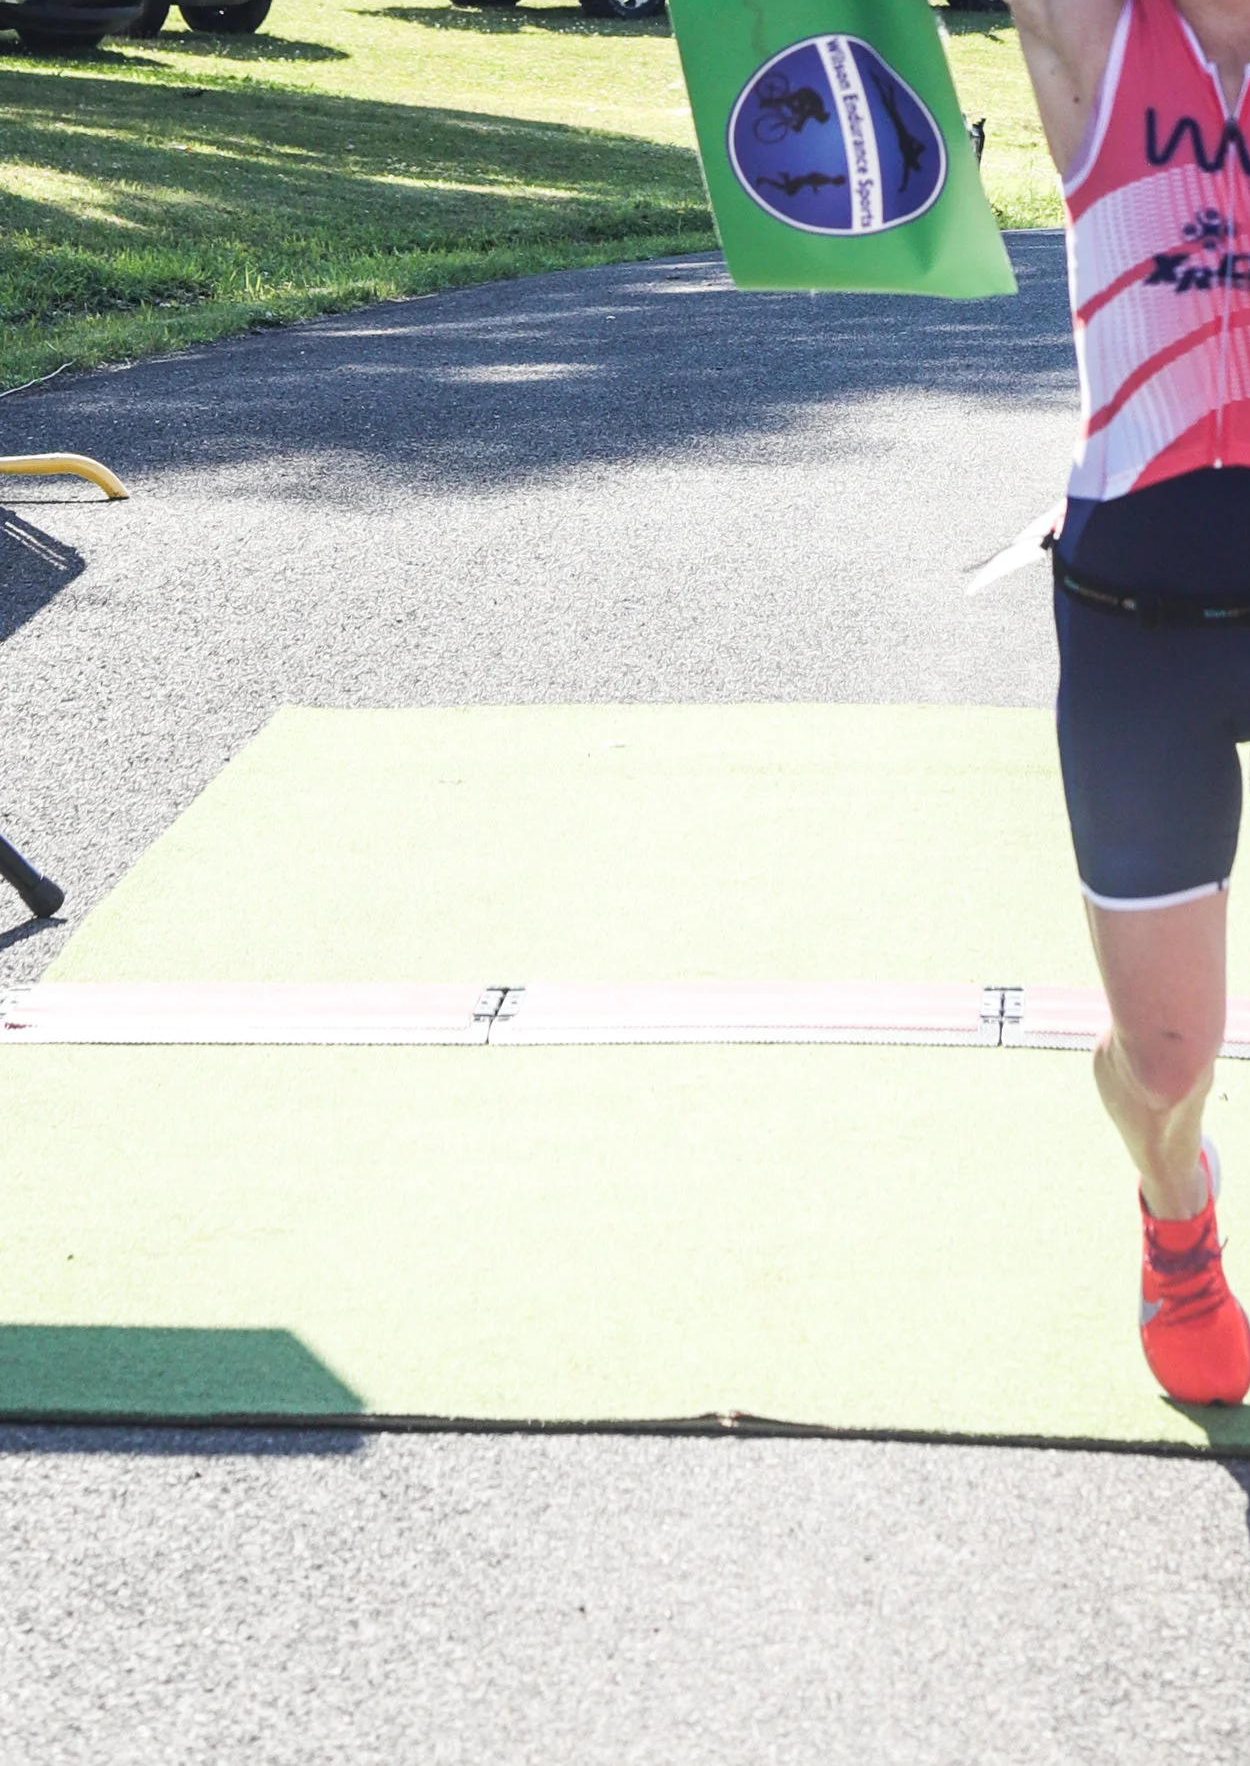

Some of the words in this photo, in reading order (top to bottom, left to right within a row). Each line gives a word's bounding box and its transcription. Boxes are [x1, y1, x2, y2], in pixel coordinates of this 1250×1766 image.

[826, 37, 851, 89] Wilson
[842, 93, 869, 175] Endurance
[855, 177, 874, 229] Sports
